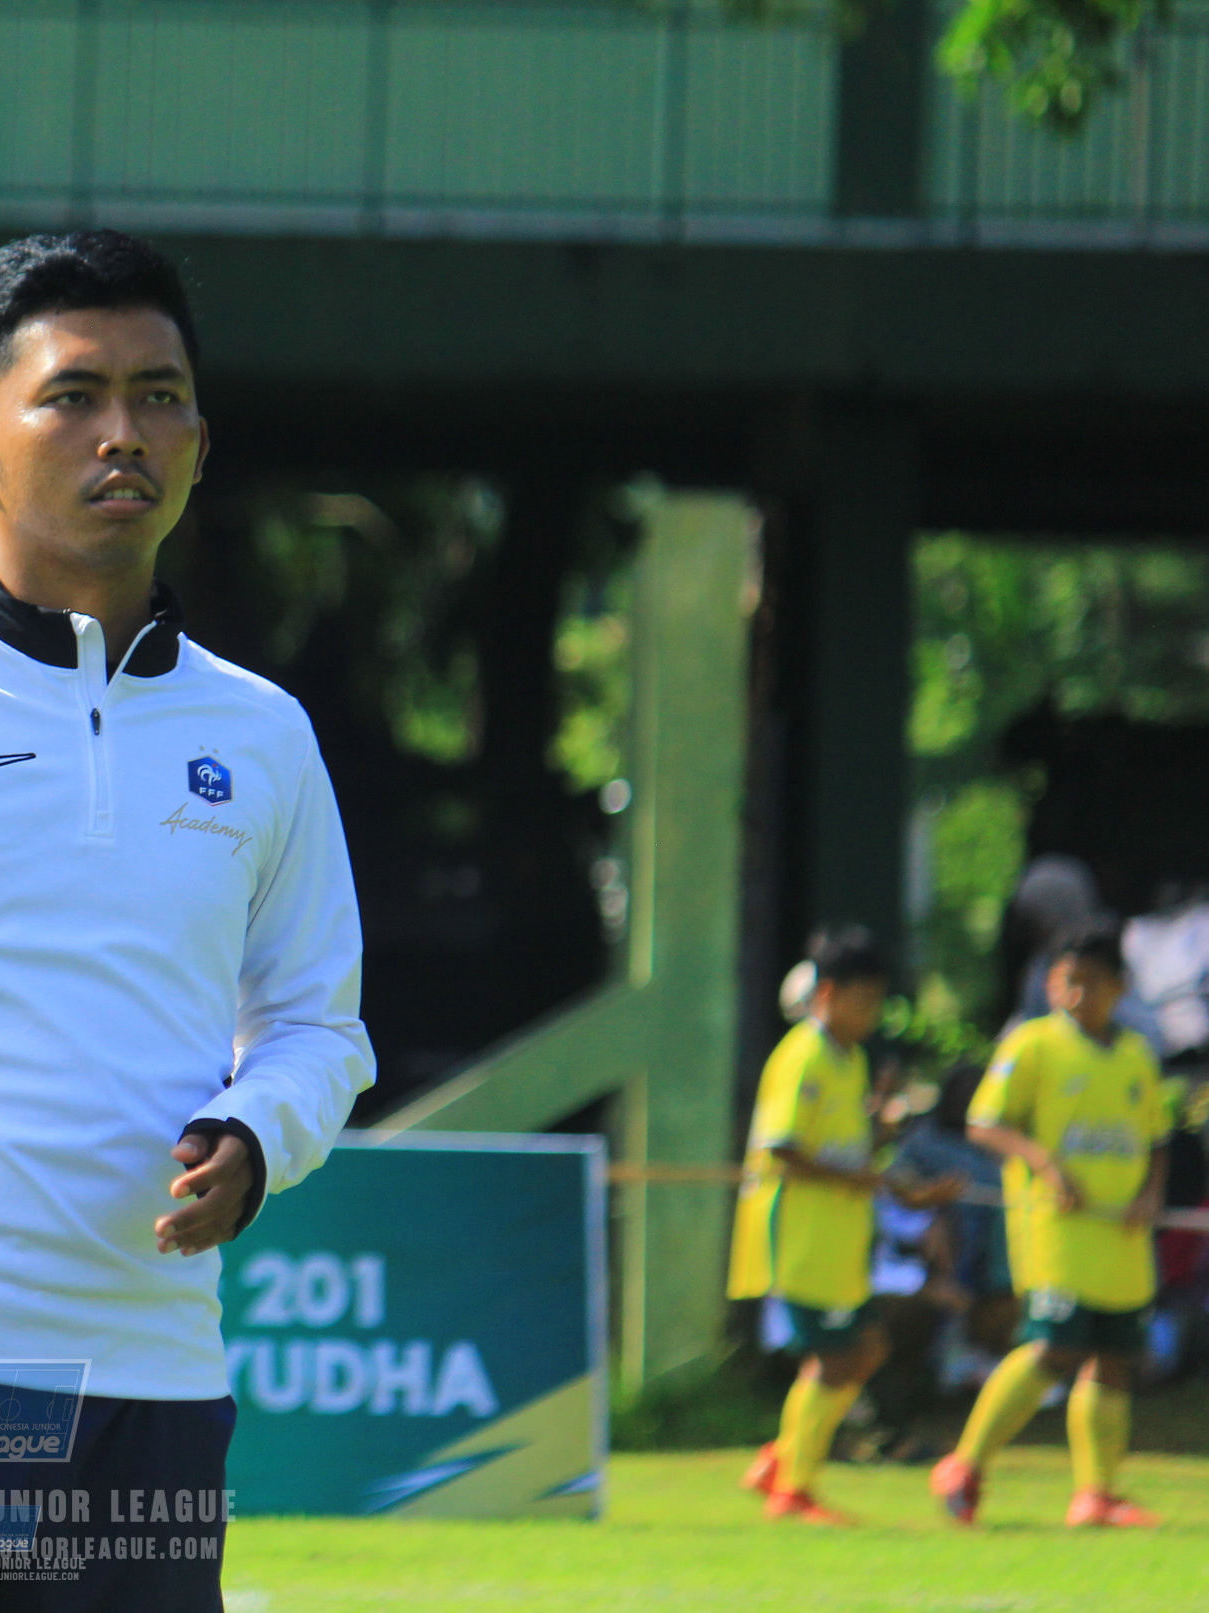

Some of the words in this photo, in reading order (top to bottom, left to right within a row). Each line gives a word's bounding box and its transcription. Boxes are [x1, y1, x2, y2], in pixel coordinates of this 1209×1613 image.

[199, 787, 224, 798] FFF
[159, 802, 253, 856] Academy
[242, 1251, 387, 1328] 201
